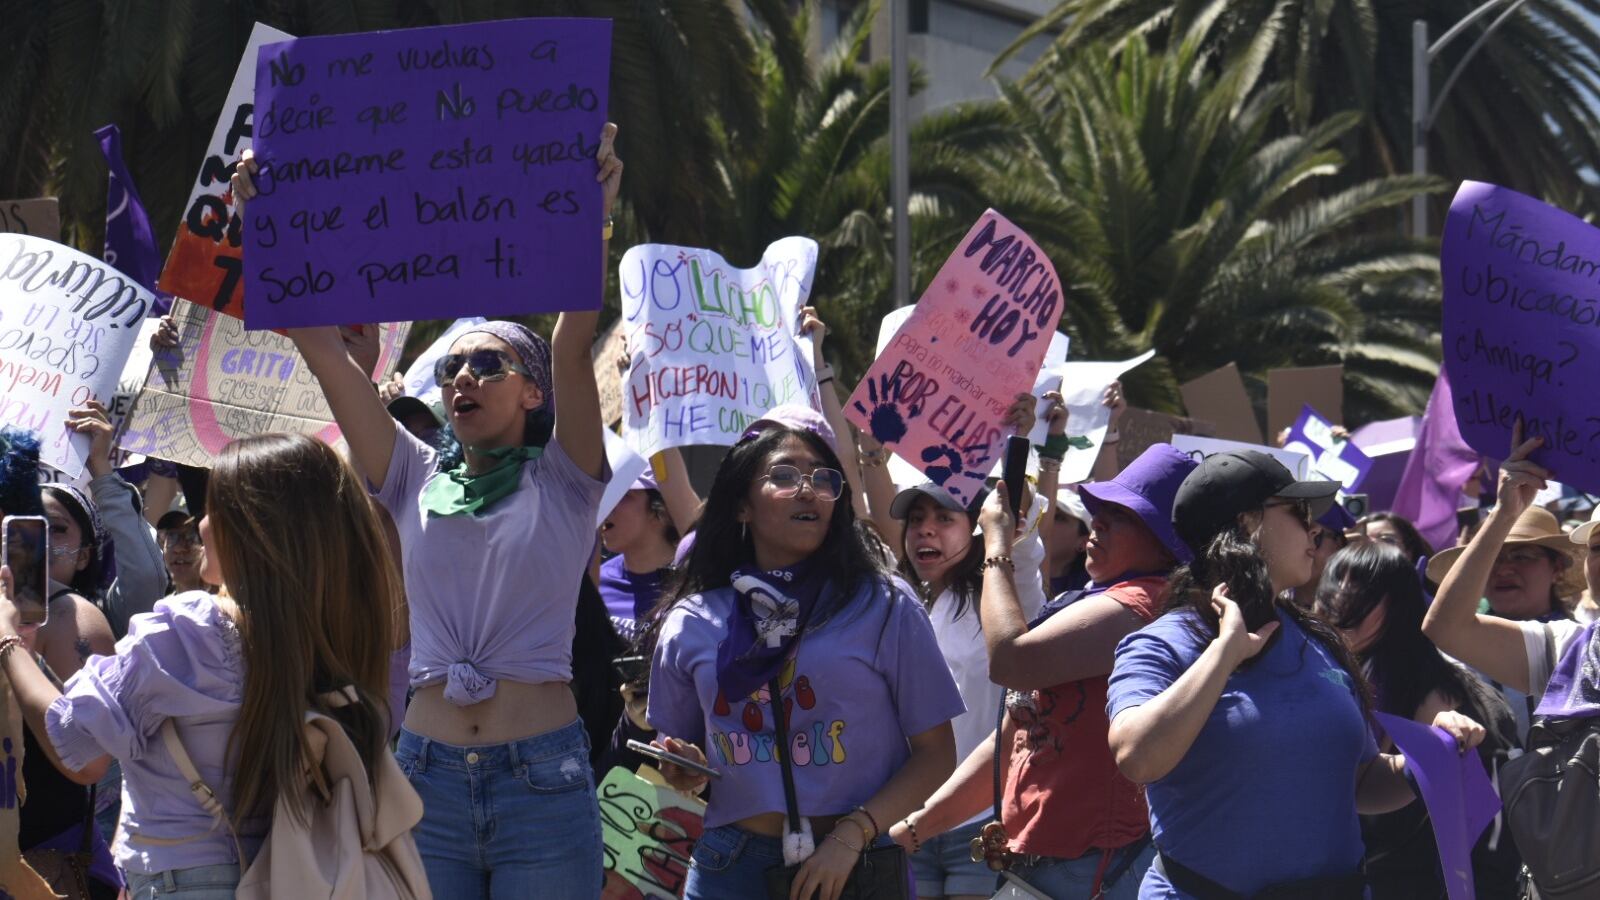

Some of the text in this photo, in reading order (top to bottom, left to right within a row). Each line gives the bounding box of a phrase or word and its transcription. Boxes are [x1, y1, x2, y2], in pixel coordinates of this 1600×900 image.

[268, 40, 559, 88] No me vuelvas a
[258, 94, 337, 139] decir
[357, 102, 409, 135] que
[436, 82, 477, 120] No
[496, 83, 599, 120] puedo
[253, 148, 406, 196] ganarme
[428, 137, 494, 170] esta
[254, 185, 581, 249] y que el balón es
[1466, 203, 1600, 286] Mándam
[357, 254, 460, 299] para
[484, 236, 523, 279] ti.
[622, 258, 683, 321] YO
[690, 258, 777, 328] LUCHO
[964, 219, 1059, 330] MARCHO
[23, 303, 59, 330] LA
[688, 319, 749, 357] QUE
[750, 330, 788, 364] ME
[970, 294, 1038, 358] HOY
[0, 361, 63, 399] vuelv
[220, 346, 296, 382] GRITO
[632, 362, 738, 418] HICIERON
[895, 332, 927, 363] para
[942, 363, 986, 398] marchar
[664, 404, 715, 438] HE
[927, 393, 1002, 470] ELLAS
